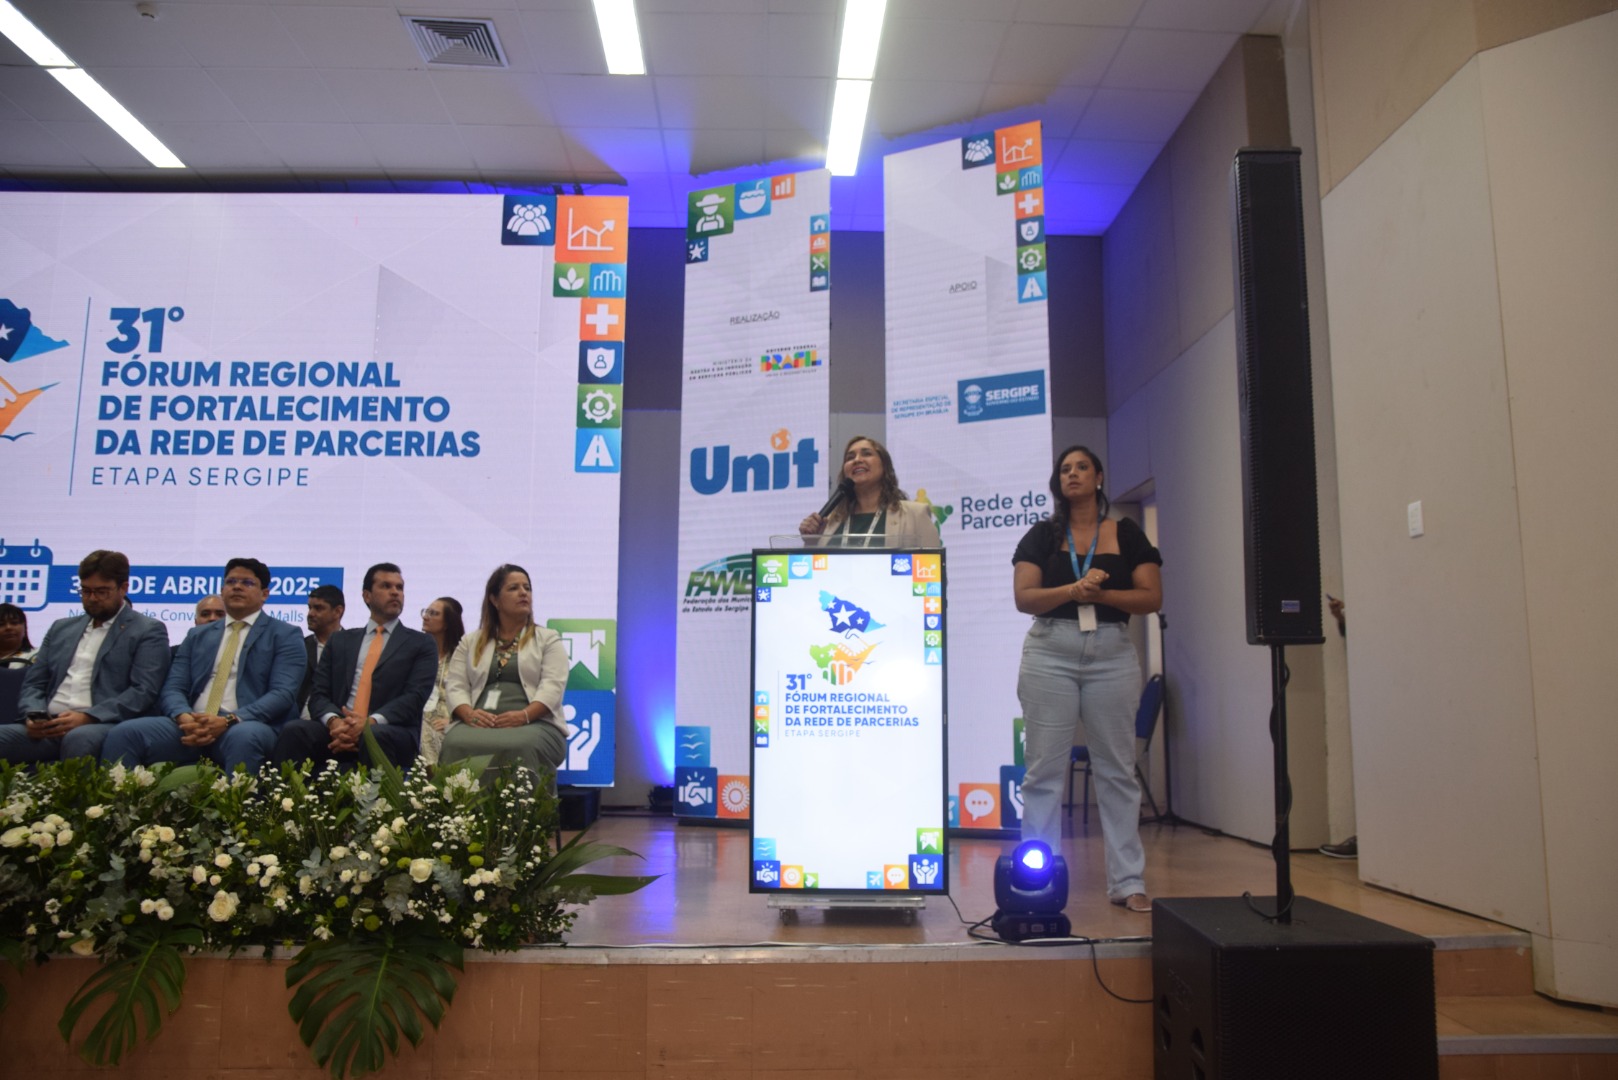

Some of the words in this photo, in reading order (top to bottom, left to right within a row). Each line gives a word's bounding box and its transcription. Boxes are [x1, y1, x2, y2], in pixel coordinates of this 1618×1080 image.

[949, 280, 977, 294] APOIO
[730, 310, 780, 326] REALIZAÇÃO
[760, 349, 822, 372] BRASIL
[101, 353, 221, 388] FÓRUM
[229, 361, 401, 388] REGIONAL
[985, 384, 1039, 401] SERGIPE
[98, 395, 142, 421] DE
[149, 394, 450, 423] FORTALECIMENTO
[95, 429, 141, 456] DA
[150, 429, 235, 456] REDE
[243, 430, 287, 456] DE
[294, 430, 481, 458] PARCERIAS
[690, 428, 819, 495] Unit
[92, 467, 177, 486] ETAPA
[188, 467, 309, 487] SERGIPE
[961, 493, 1013, 513] Rede
[1020, 490, 1047, 508] de
[961, 507, 1050, 530] Parcerias
[128, 576, 156, 594] DE
[785, 691, 827, 702] FÓRUM
[830, 693, 890, 702] REGIONAL
[785, 705, 800, 714] DE
[803, 705, 908, 715] FORTALECIMENTO
[785, 717, 801, 726] DA
[804, 717, 834, 727] REDE
[837, 717, 851, 727] DE
[854, 717, 919, 727] PARCERIAS
[818, 730, 861, 738] SERGIPE
